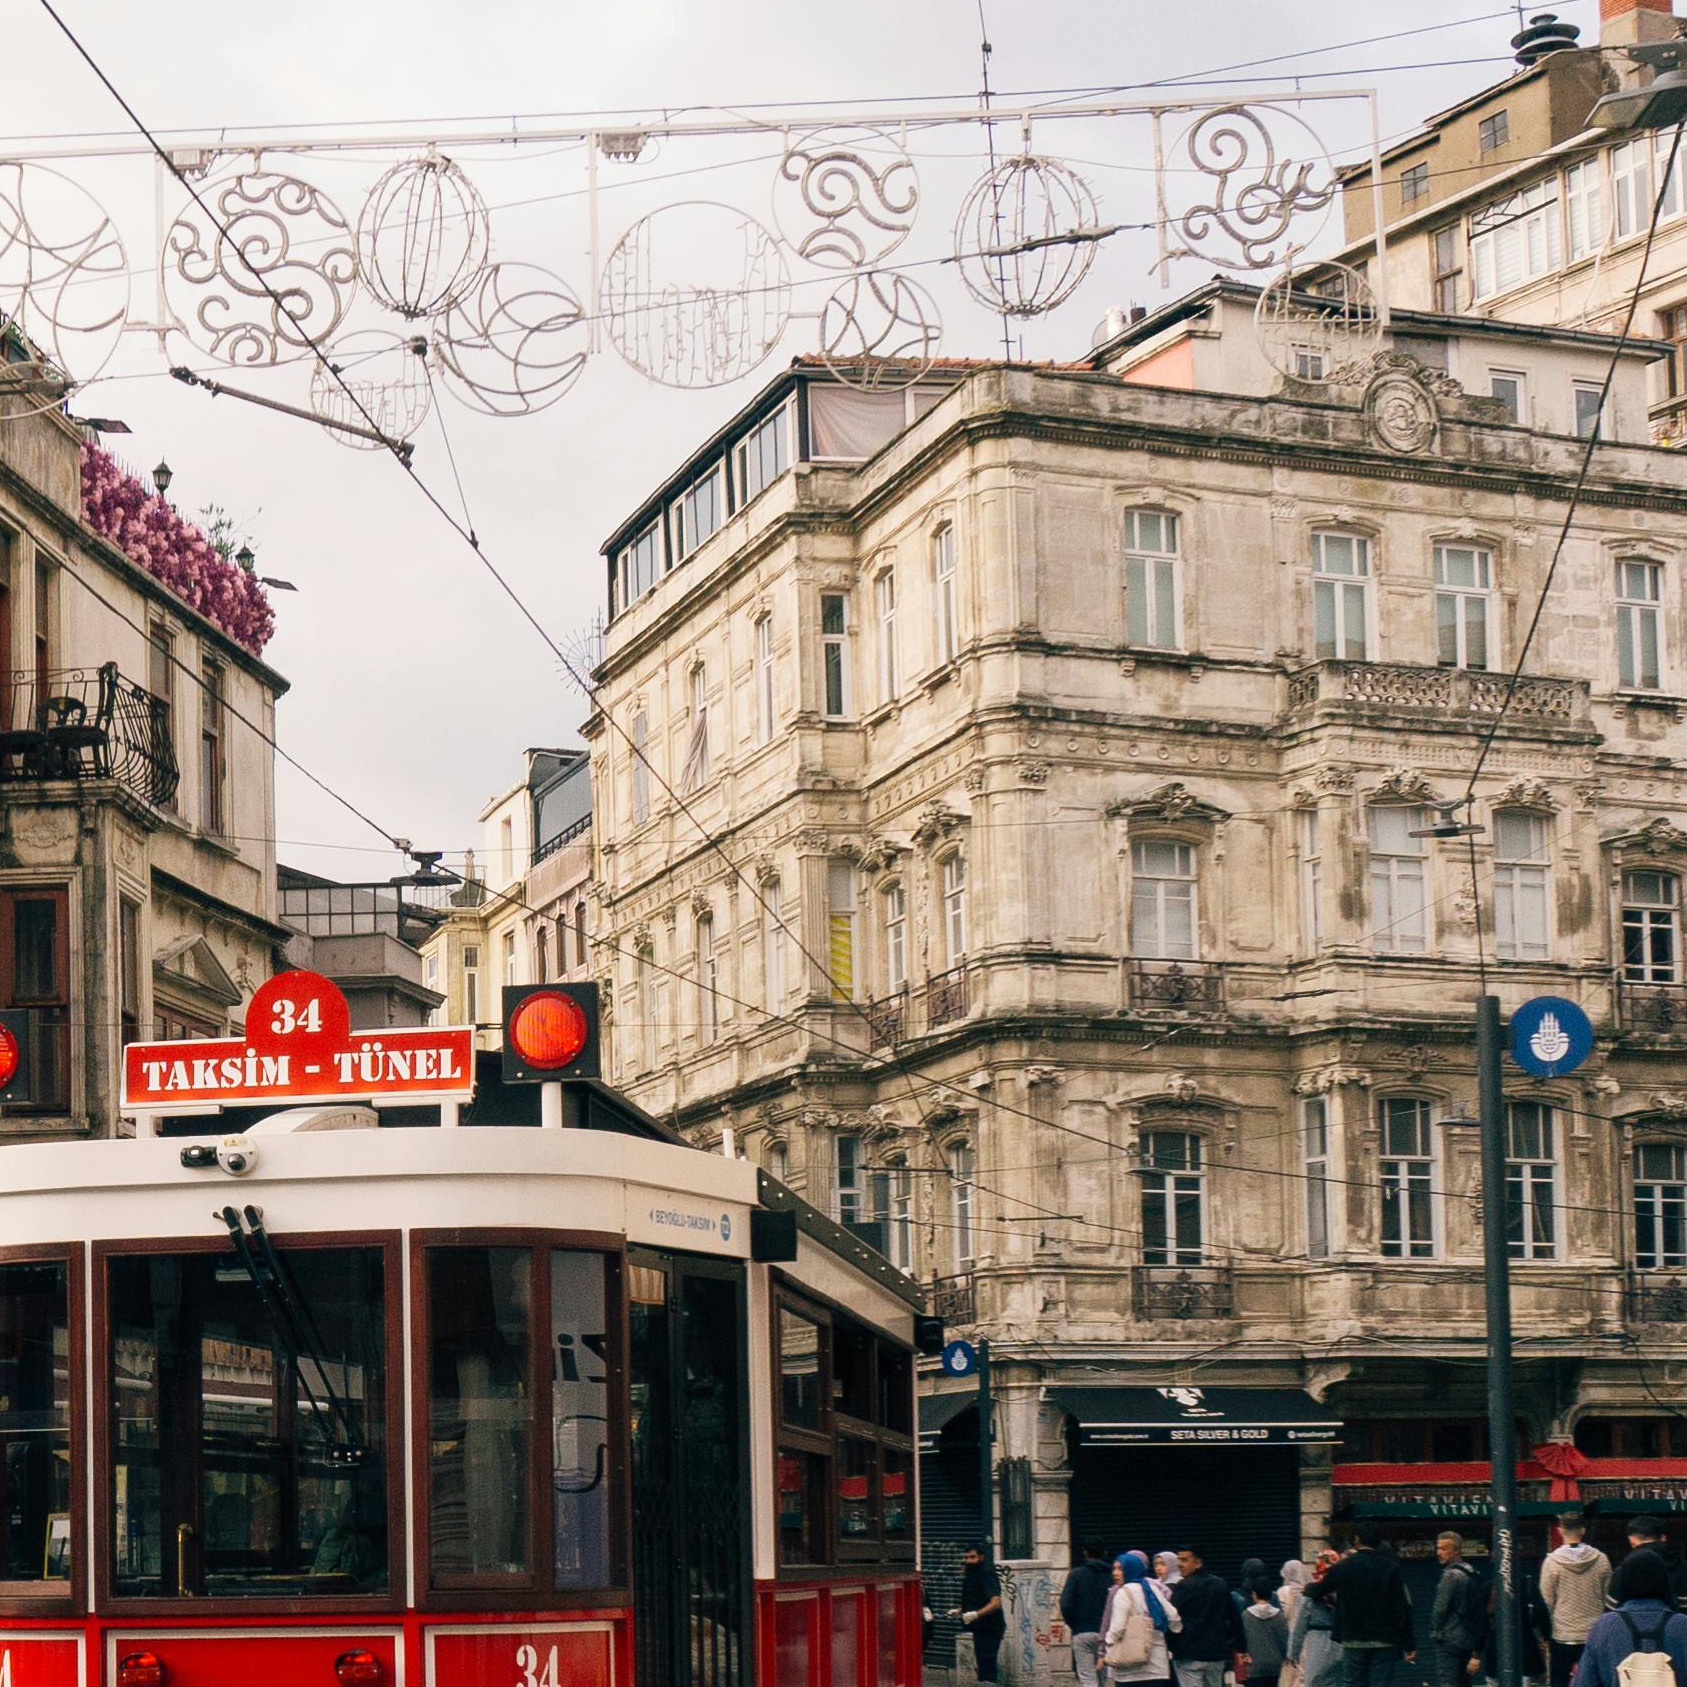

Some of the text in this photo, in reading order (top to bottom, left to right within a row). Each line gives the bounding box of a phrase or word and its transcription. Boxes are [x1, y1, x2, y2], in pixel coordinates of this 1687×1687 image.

[271, 998, 322, 1034] 34
[142, 1048, 290, 1091] TAKSİM
[334, 1042, 461, 1083] TÜNEL
[1170, 1429, 1268, 1440] SETA SILVER & GOLD
